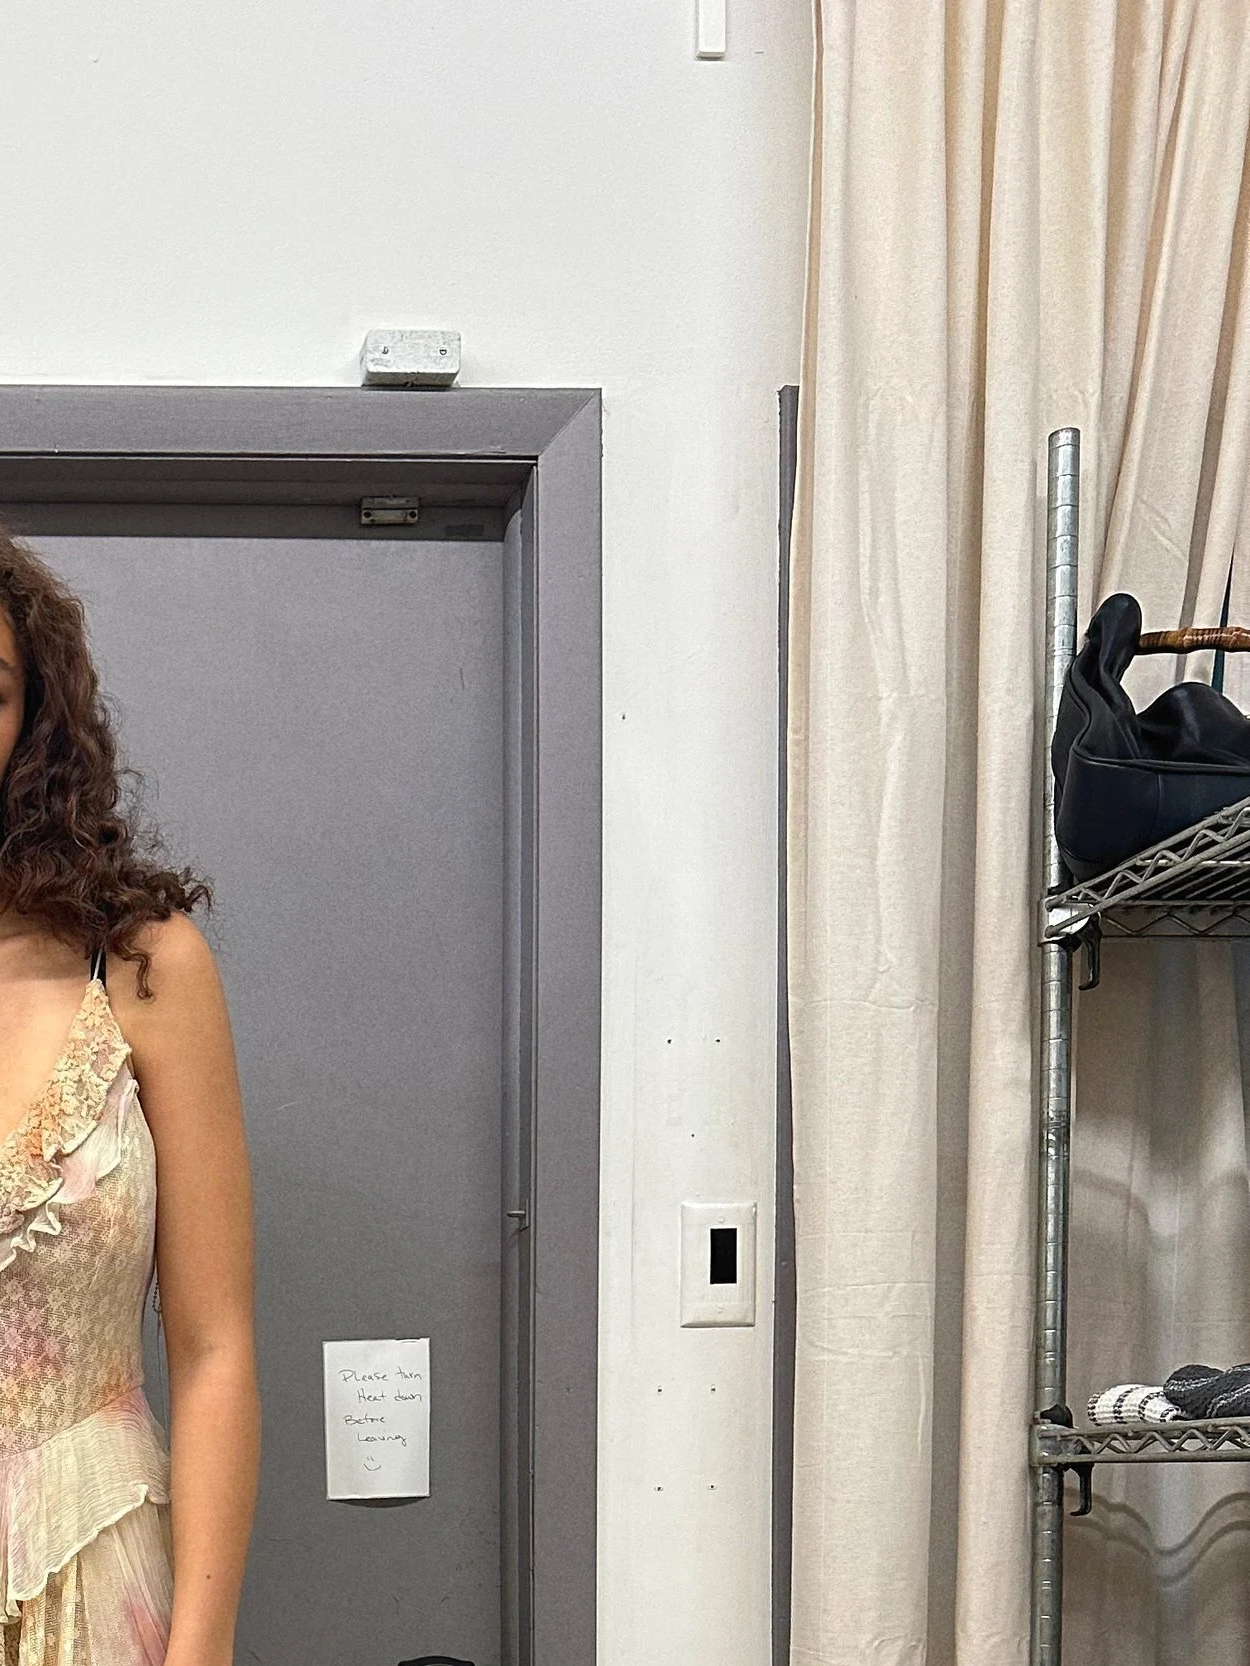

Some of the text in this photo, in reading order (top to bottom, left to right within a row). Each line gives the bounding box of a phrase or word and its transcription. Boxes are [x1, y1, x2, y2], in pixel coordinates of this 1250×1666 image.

[338, 1366, 422, 1383] Please turn
[357, 1388, 422, 1403] Heat down
[343, 1413, 386, 1425] Before
